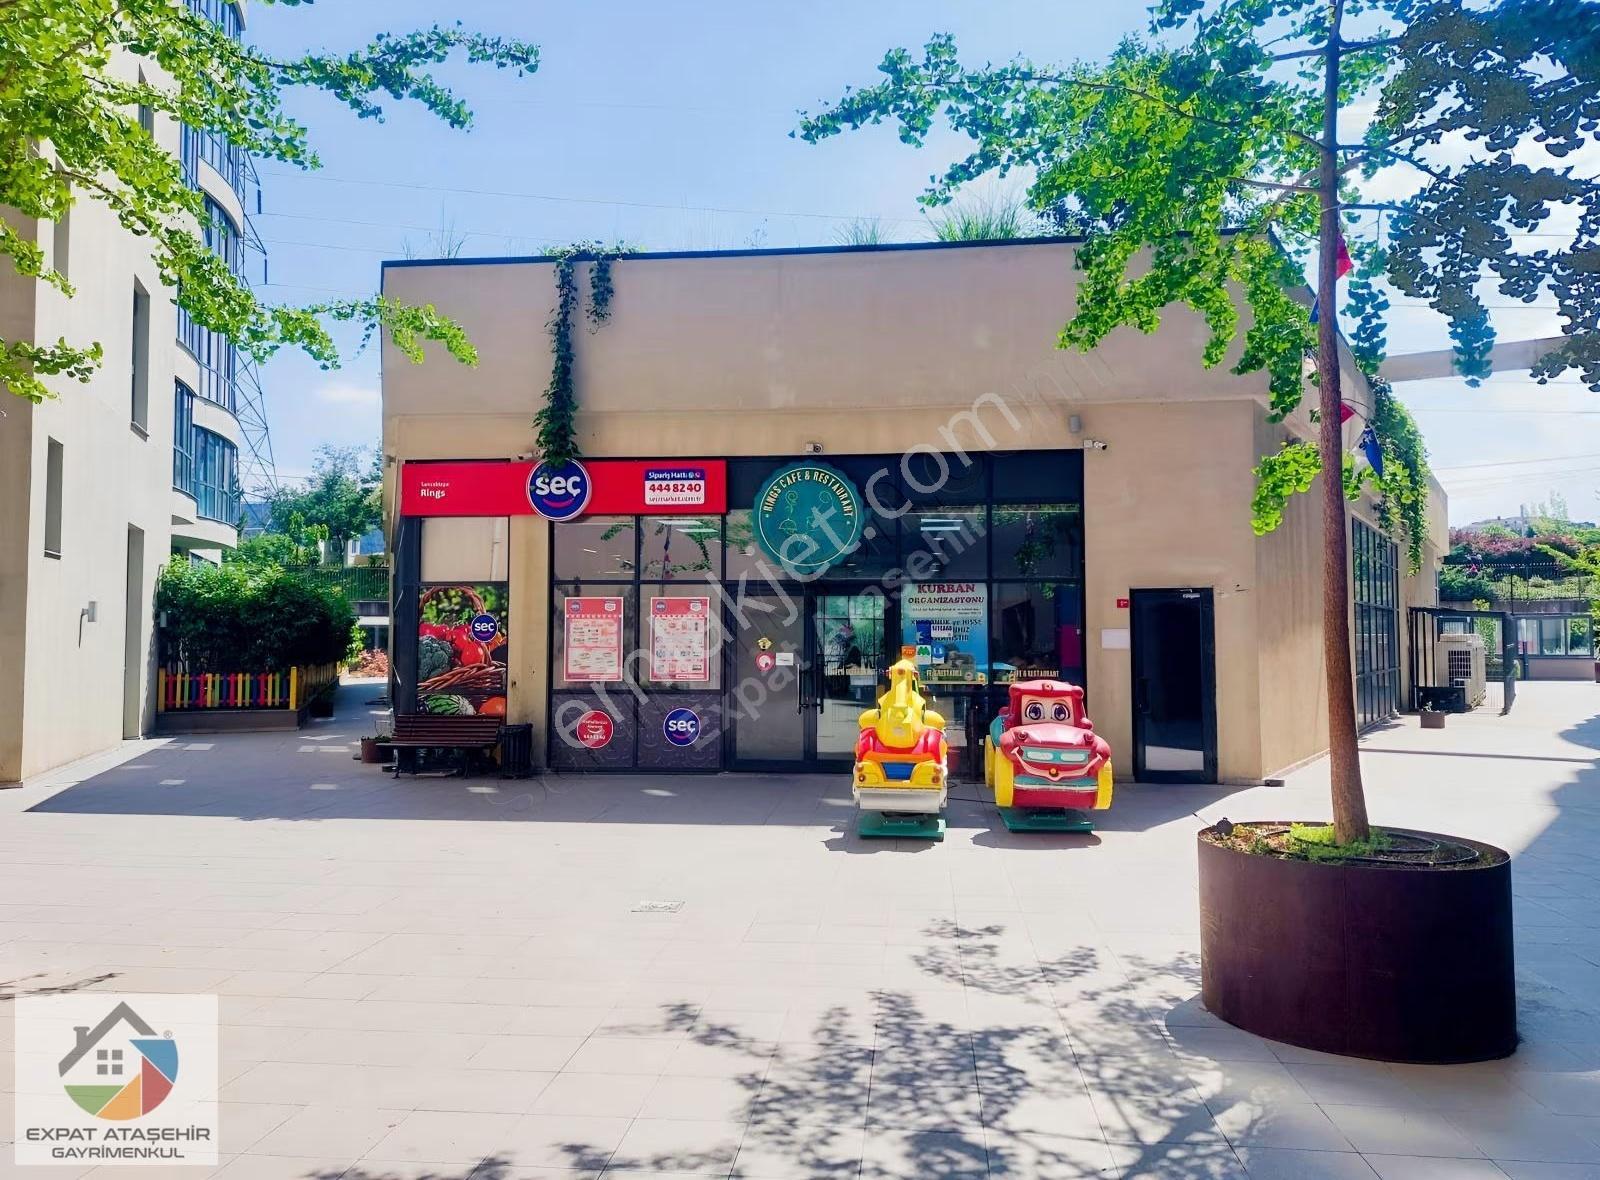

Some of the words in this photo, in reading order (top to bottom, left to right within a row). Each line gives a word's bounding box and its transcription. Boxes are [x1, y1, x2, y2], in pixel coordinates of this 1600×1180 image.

[535, 474, 581, 497] seç
[420, 488, 446, 500] Rings
[763, 485, 782, 512] RINGS
[780, 472, 802, 489] CAFE
[804, 470, 811, 480] &
[813, 471, 854, 517] RESTAURANT
[917, 582, 976, 594] KURBAN
[668, 719, 696, 733] seç
